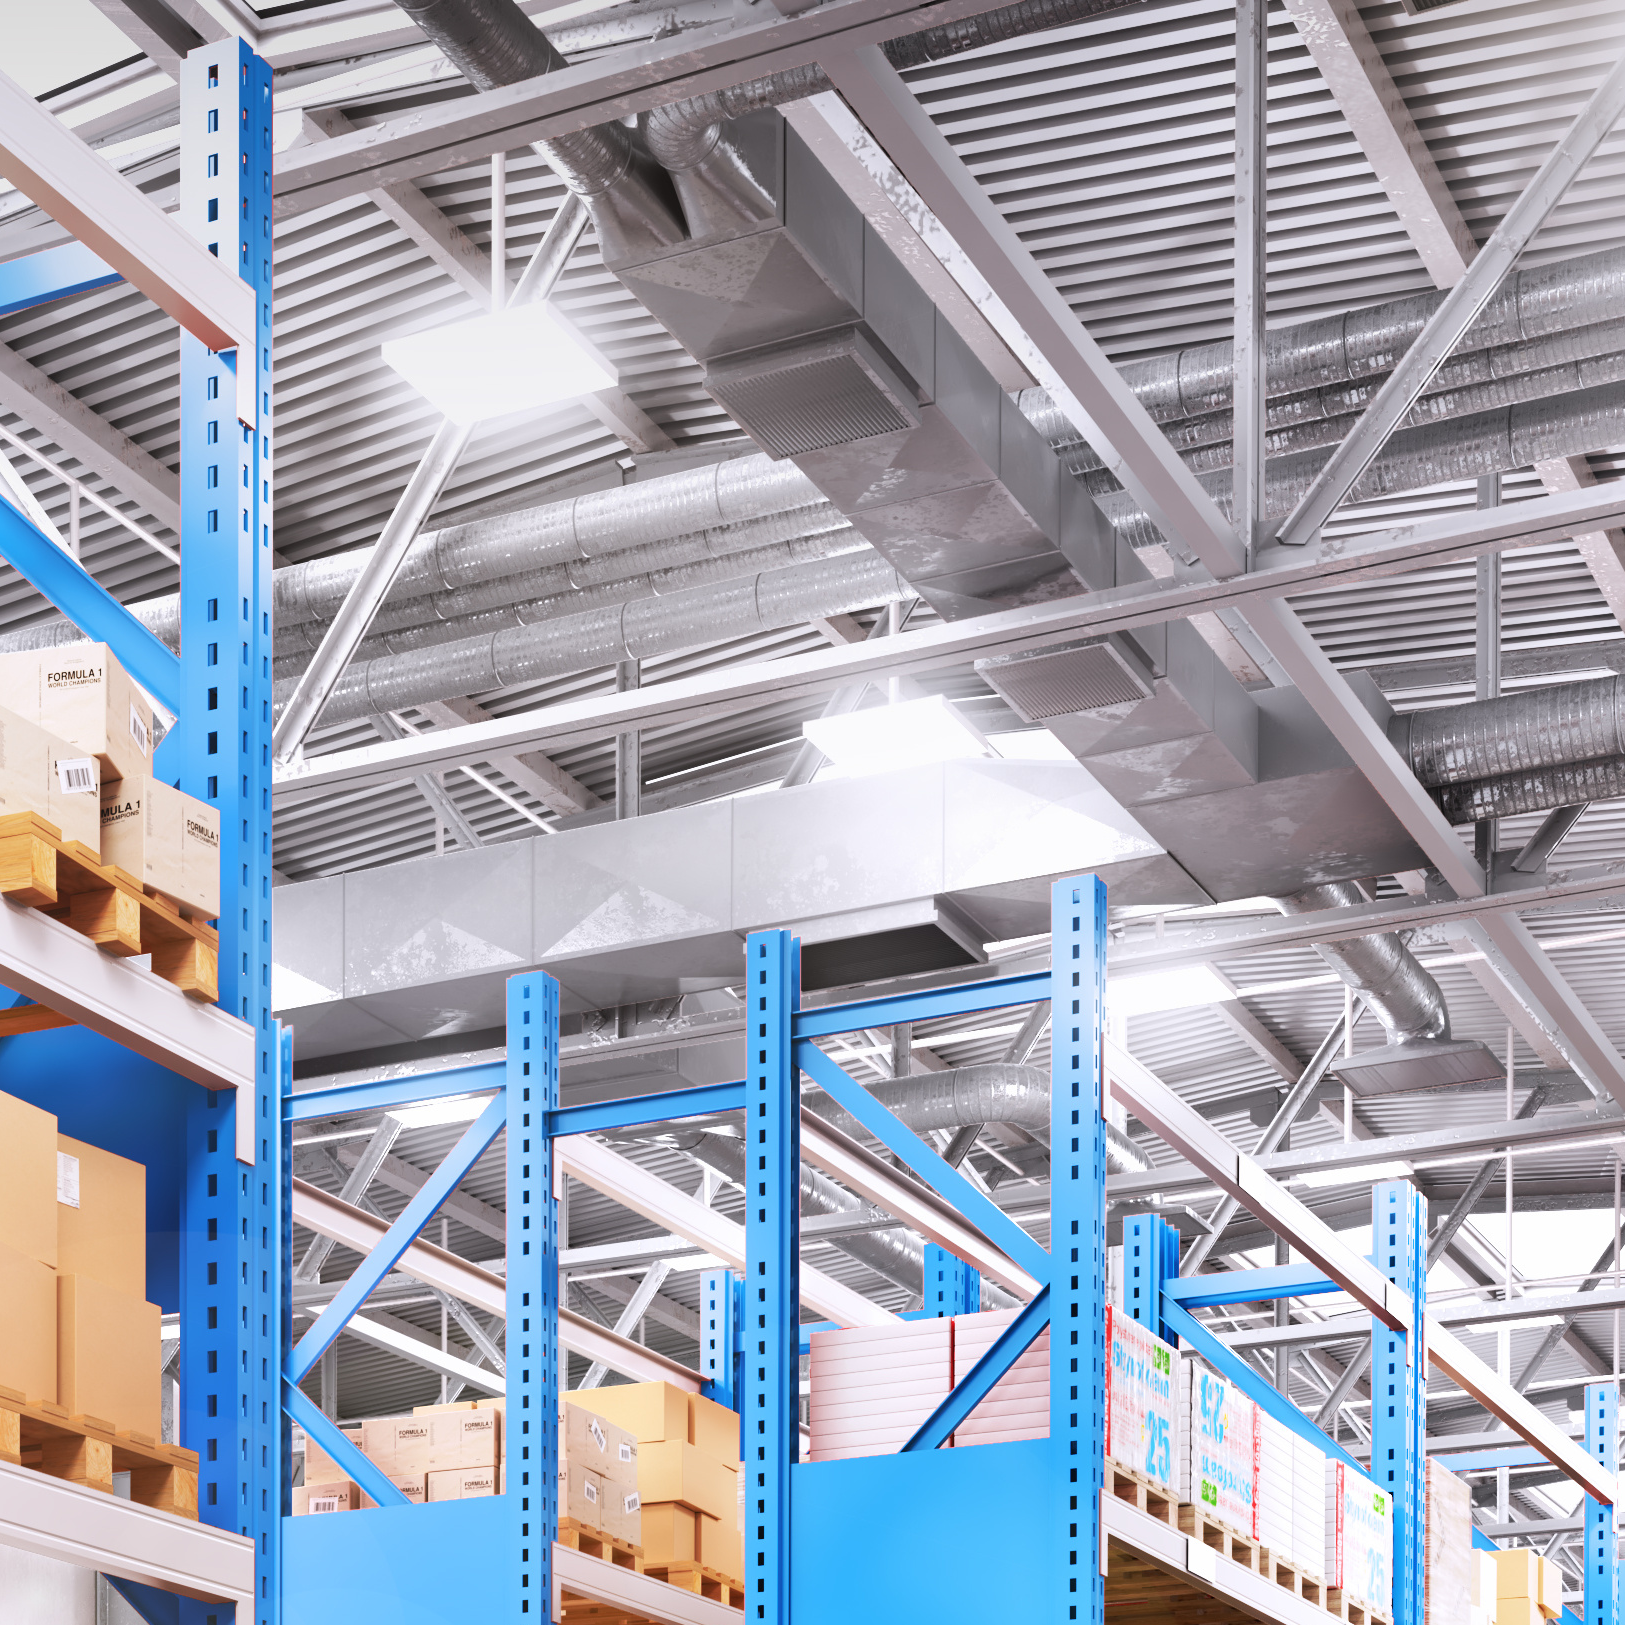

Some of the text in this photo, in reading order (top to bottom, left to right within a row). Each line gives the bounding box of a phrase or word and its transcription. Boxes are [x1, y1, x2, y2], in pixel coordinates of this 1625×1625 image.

[48, 668, 102, 682] FORMULA 1
[69, 677, 101, 687] CHAMPIONS
[187, 819, 213, 840] FORMULA
